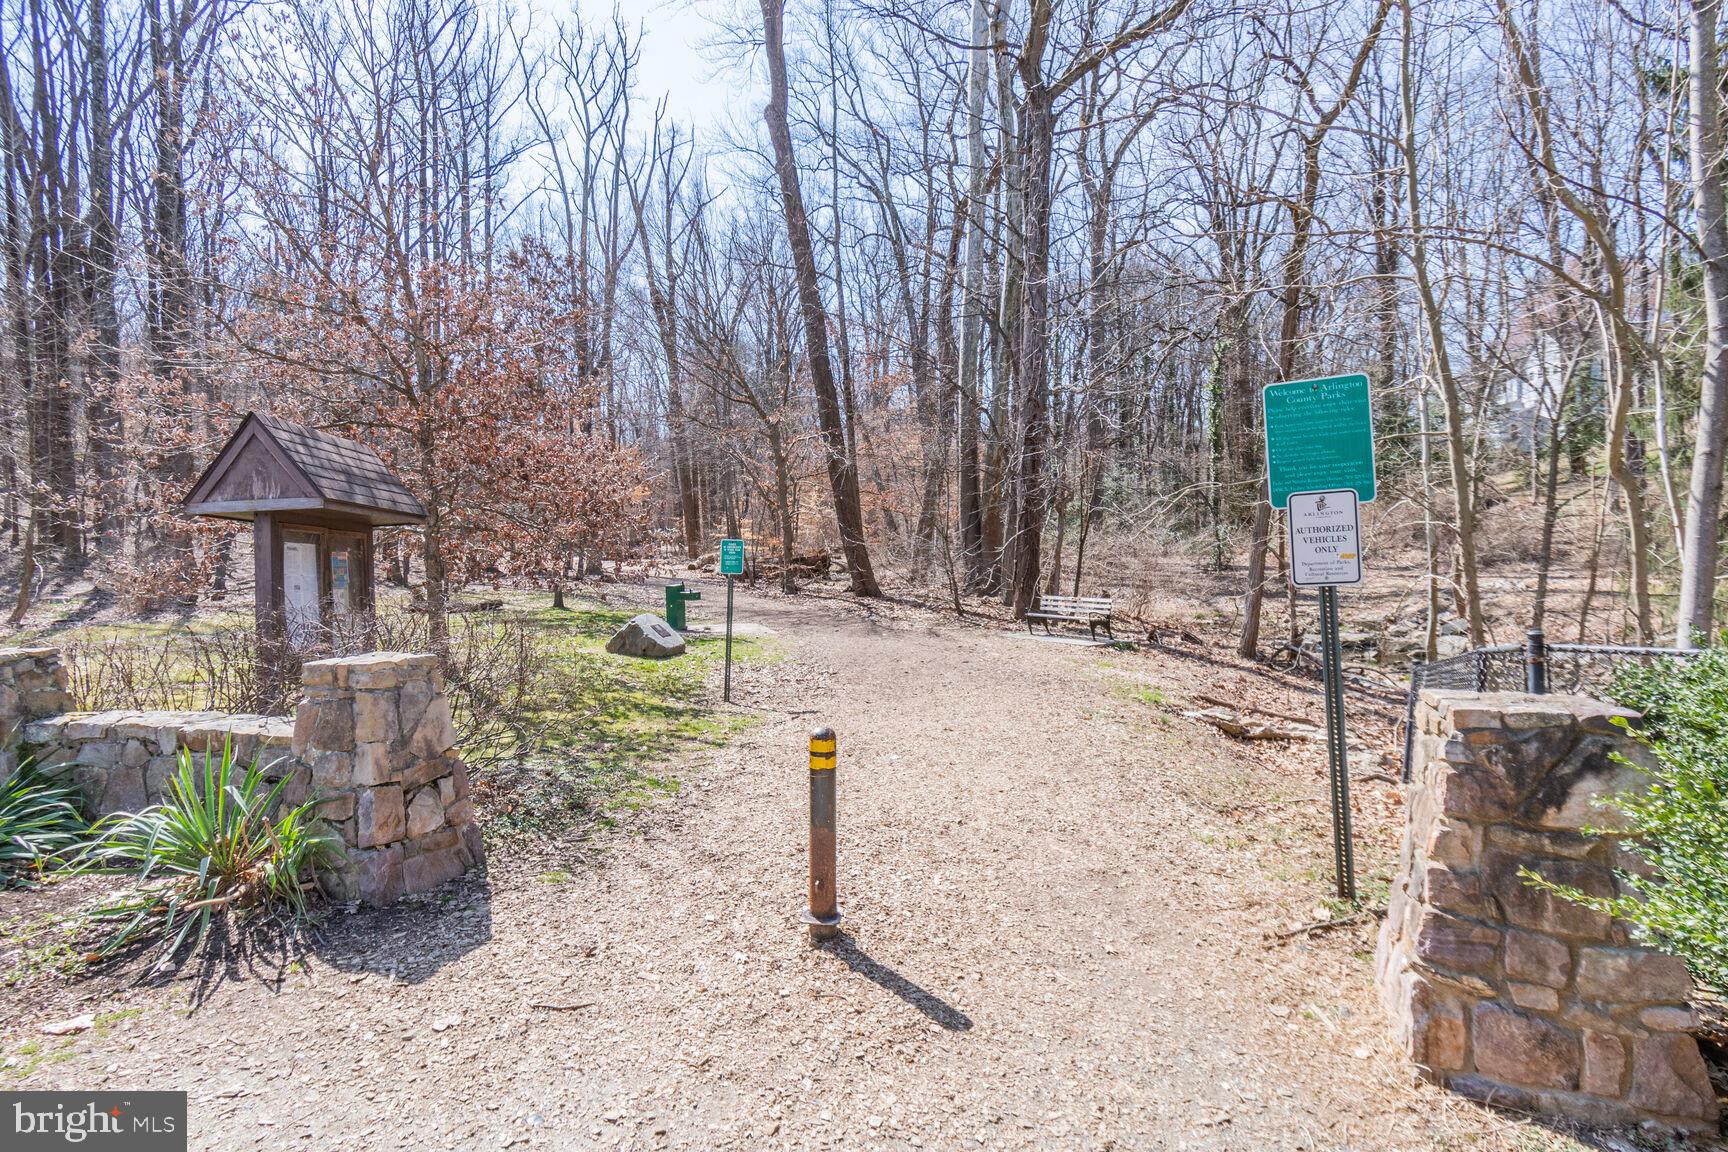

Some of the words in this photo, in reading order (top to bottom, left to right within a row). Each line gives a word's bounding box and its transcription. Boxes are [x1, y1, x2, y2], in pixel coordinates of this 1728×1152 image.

[1270, 388, 1305, 397] Welcome
[1320, 381, 1362, 391] Arlington
[1287, 395, 1318, 404] County
[1321, 391, 1346, 400] Parks
[1296, 524, 1354, 534] AUTHORIZED
[1302, 535, 1347, 544] VEHICLES
